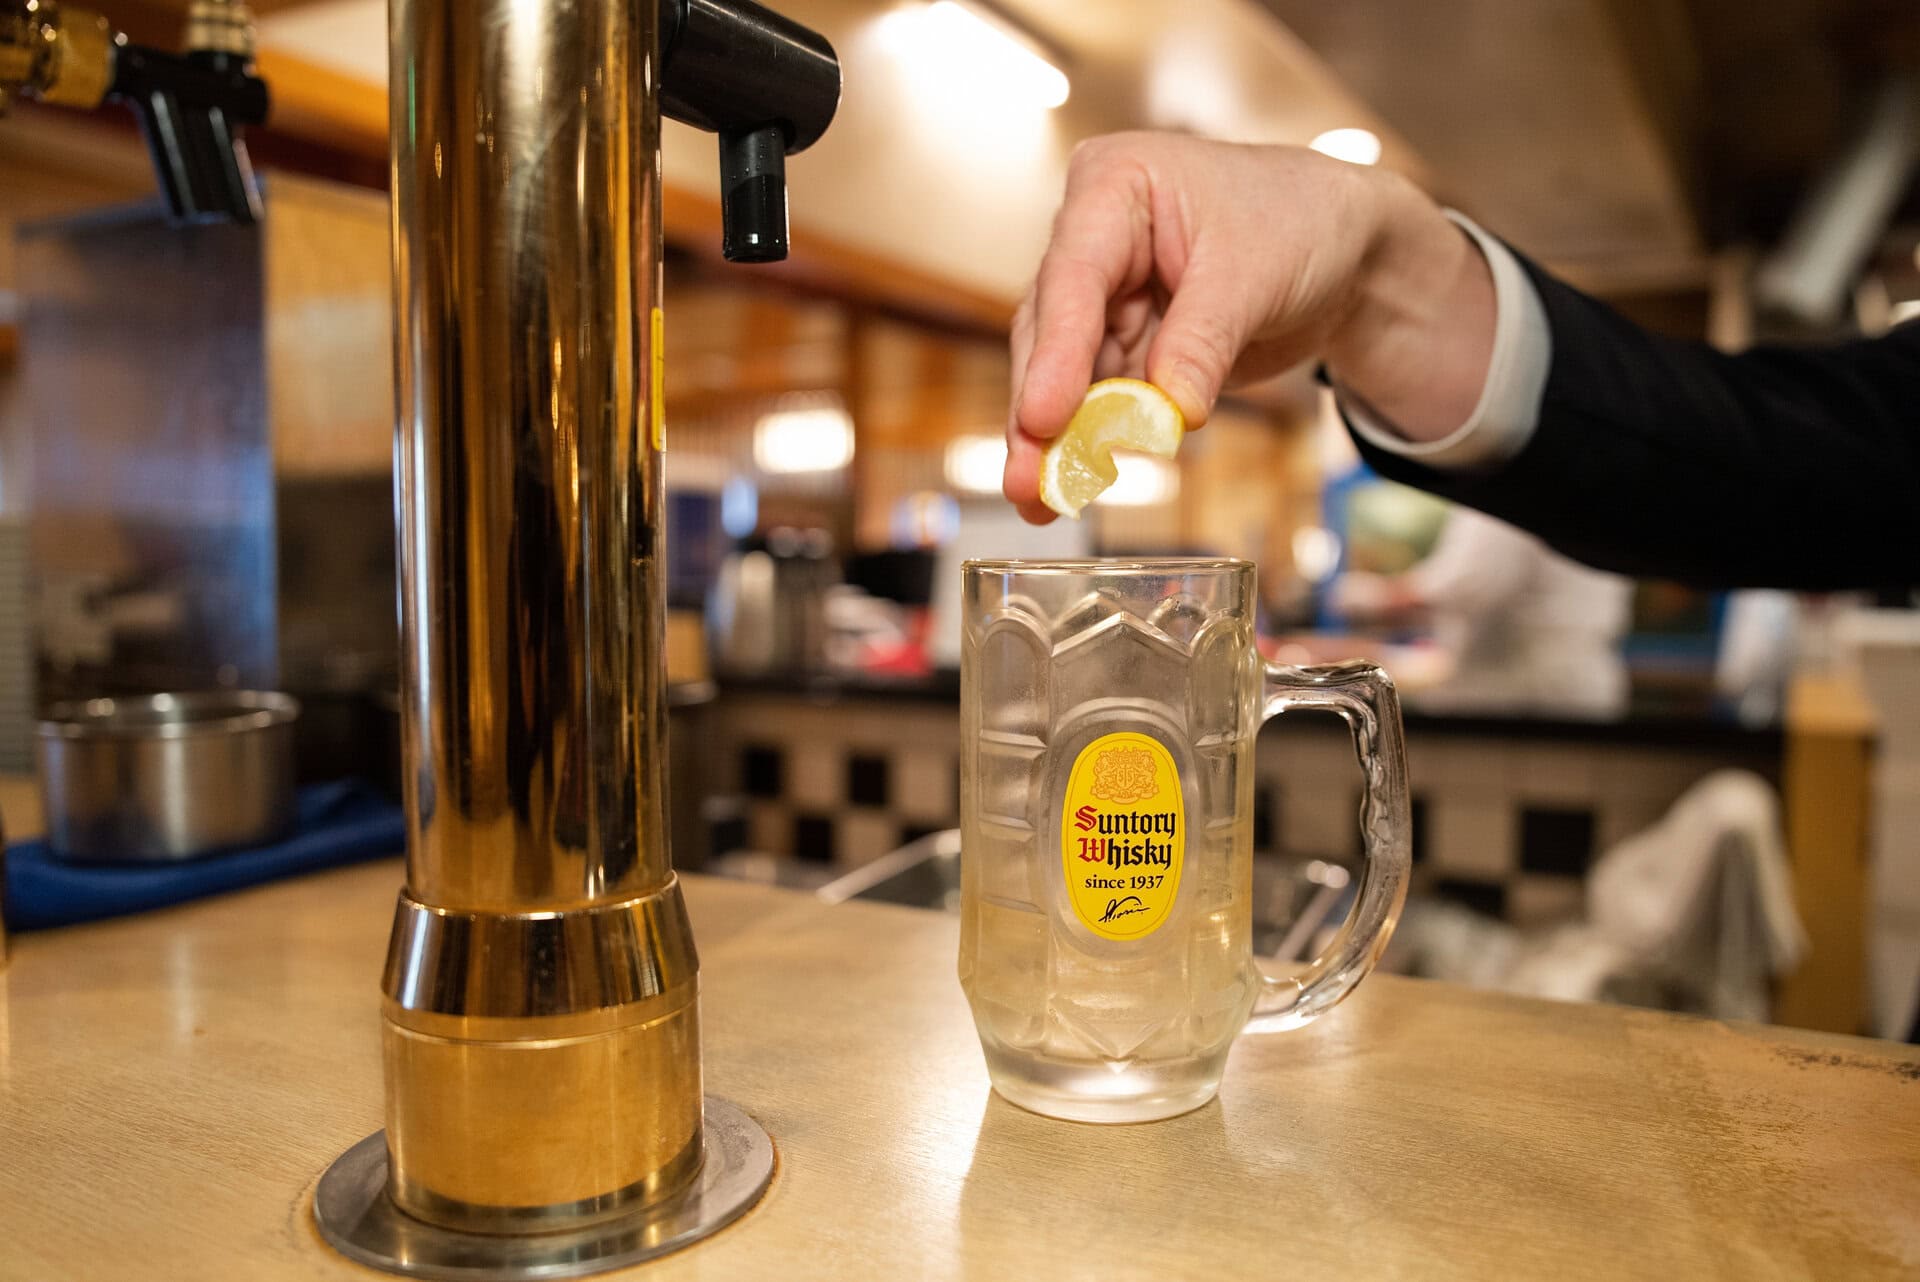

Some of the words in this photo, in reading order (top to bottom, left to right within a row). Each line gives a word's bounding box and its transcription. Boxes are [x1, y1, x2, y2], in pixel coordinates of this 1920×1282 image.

[1074, 805, 1176, 839] Suntory
[1077, 837, 1172, 870] Whisky
[1085, 874, 1125, 889] since
[1130, 875, 1164, 890] 1937
